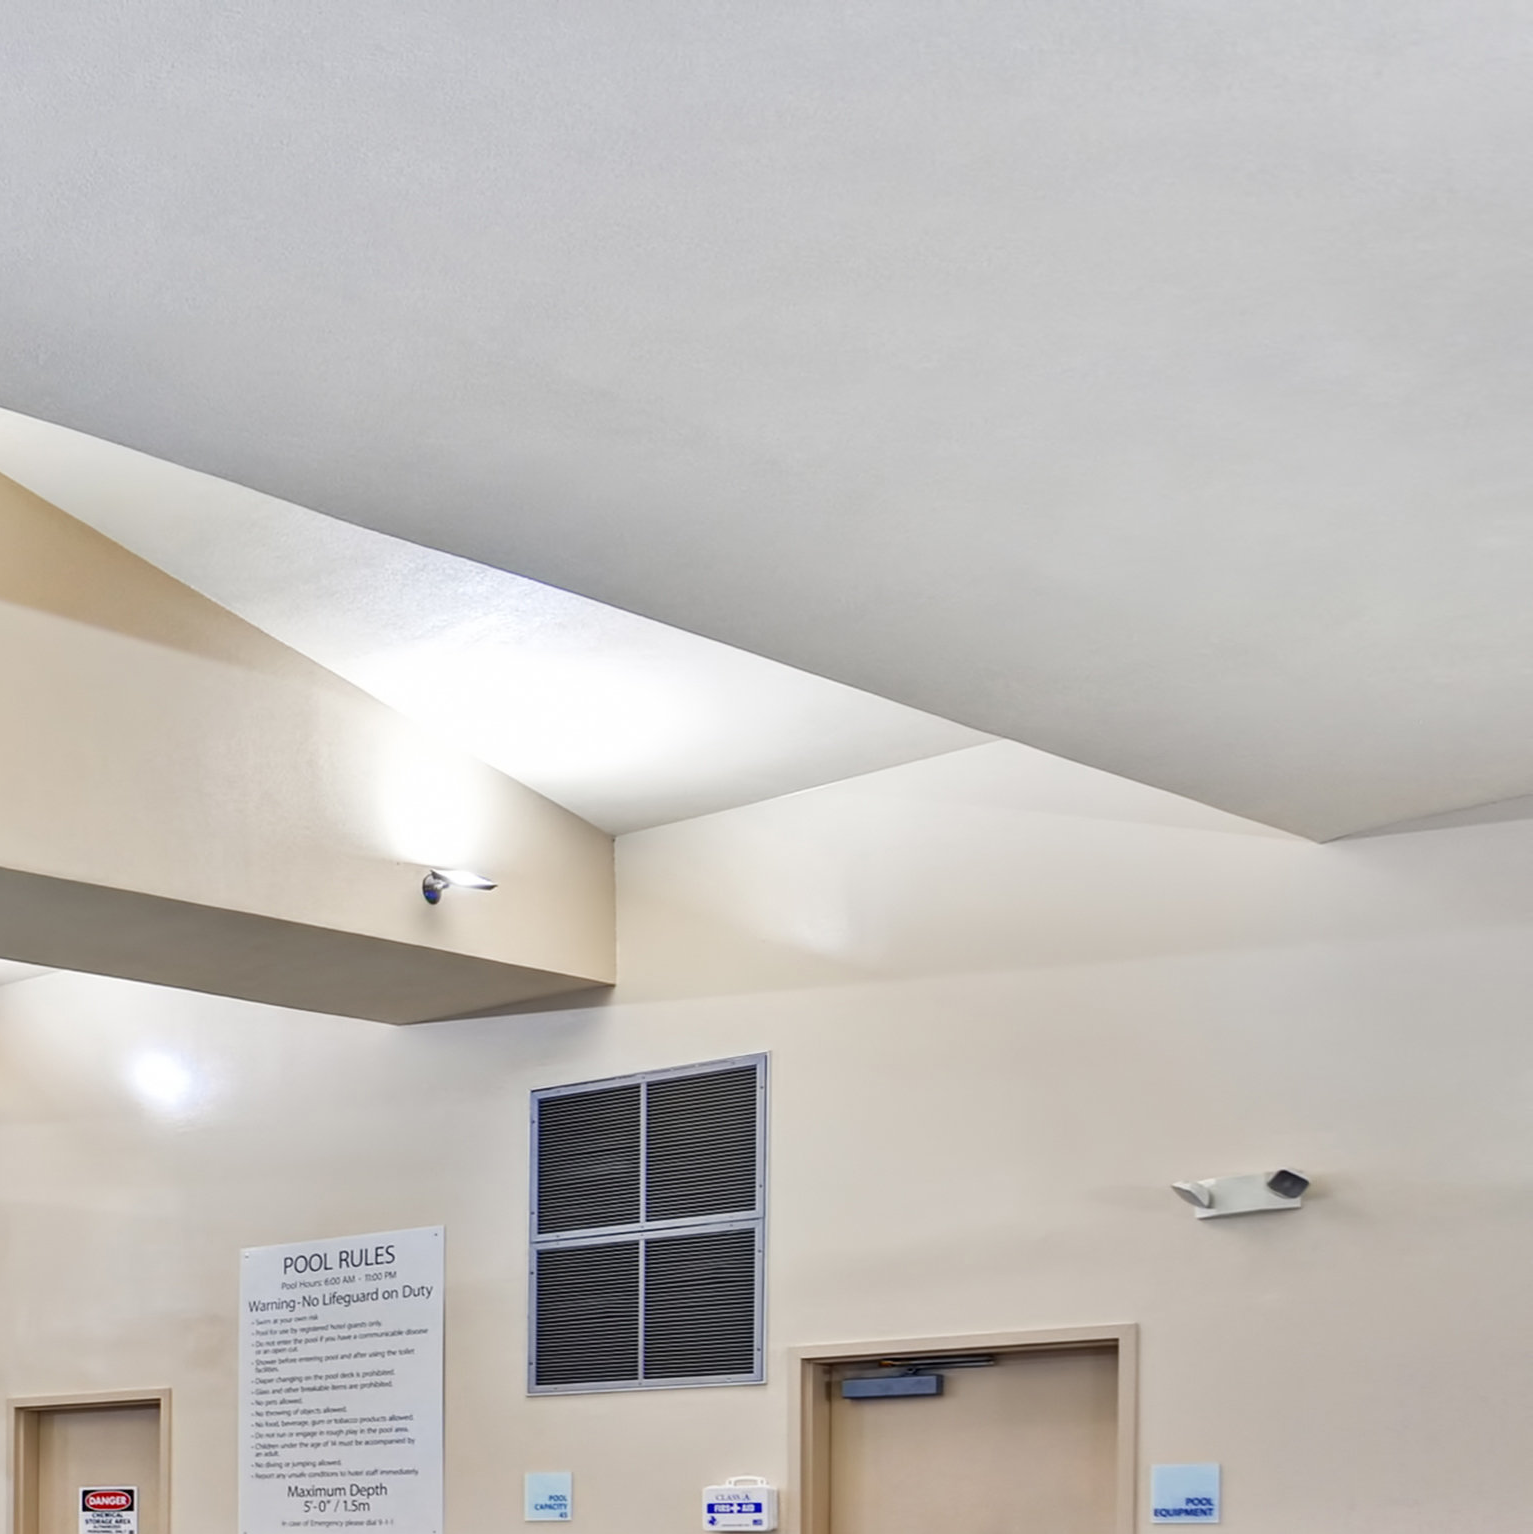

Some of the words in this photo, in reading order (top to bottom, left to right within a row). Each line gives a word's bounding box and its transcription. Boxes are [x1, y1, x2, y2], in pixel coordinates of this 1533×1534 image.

[283, 1252, 333, 1275] POOL
[338, 1245, 396, 1269] RULES
[281, 1281, 297, 1290] Pool
[343, 1275, 355, 1284] AM
[385, 1271, 397, 1280] PM
[322, 1287, 379, 1309] Lifeguard
[382, 1289, 398, 1300] on
[402, 1282, 433, 1301] Duty
[304, 1337, 318, 1345] pool
[325, 1354, 338, 1362] pool
[276, 1376, 303, 1384] changing
[324, 1373, 338, 1381] pool
[265, 1410, 291, 1418] throwing
[360, 1416, 387, 1424] products
[326, 1429, 344, 1437] rough
[287, 1484, 346, 1498] Maximum
[350, 1483, 388, 1499] Depth
[89, 1496, 127, 1505] DANGER
[548, 1494, 567, 1502] POOL
[1185, 1497, 1214, 1506] POOL
[344, 1500, 370, 1512] 1.5m
[534, 1503, 568, 1511] CAPACITY
[741, 1504, 755, 1512] AID
[1153, 1507, 1214, 1518] EQUIPMENT
[310, 1520, 343, 1528] Emergency
